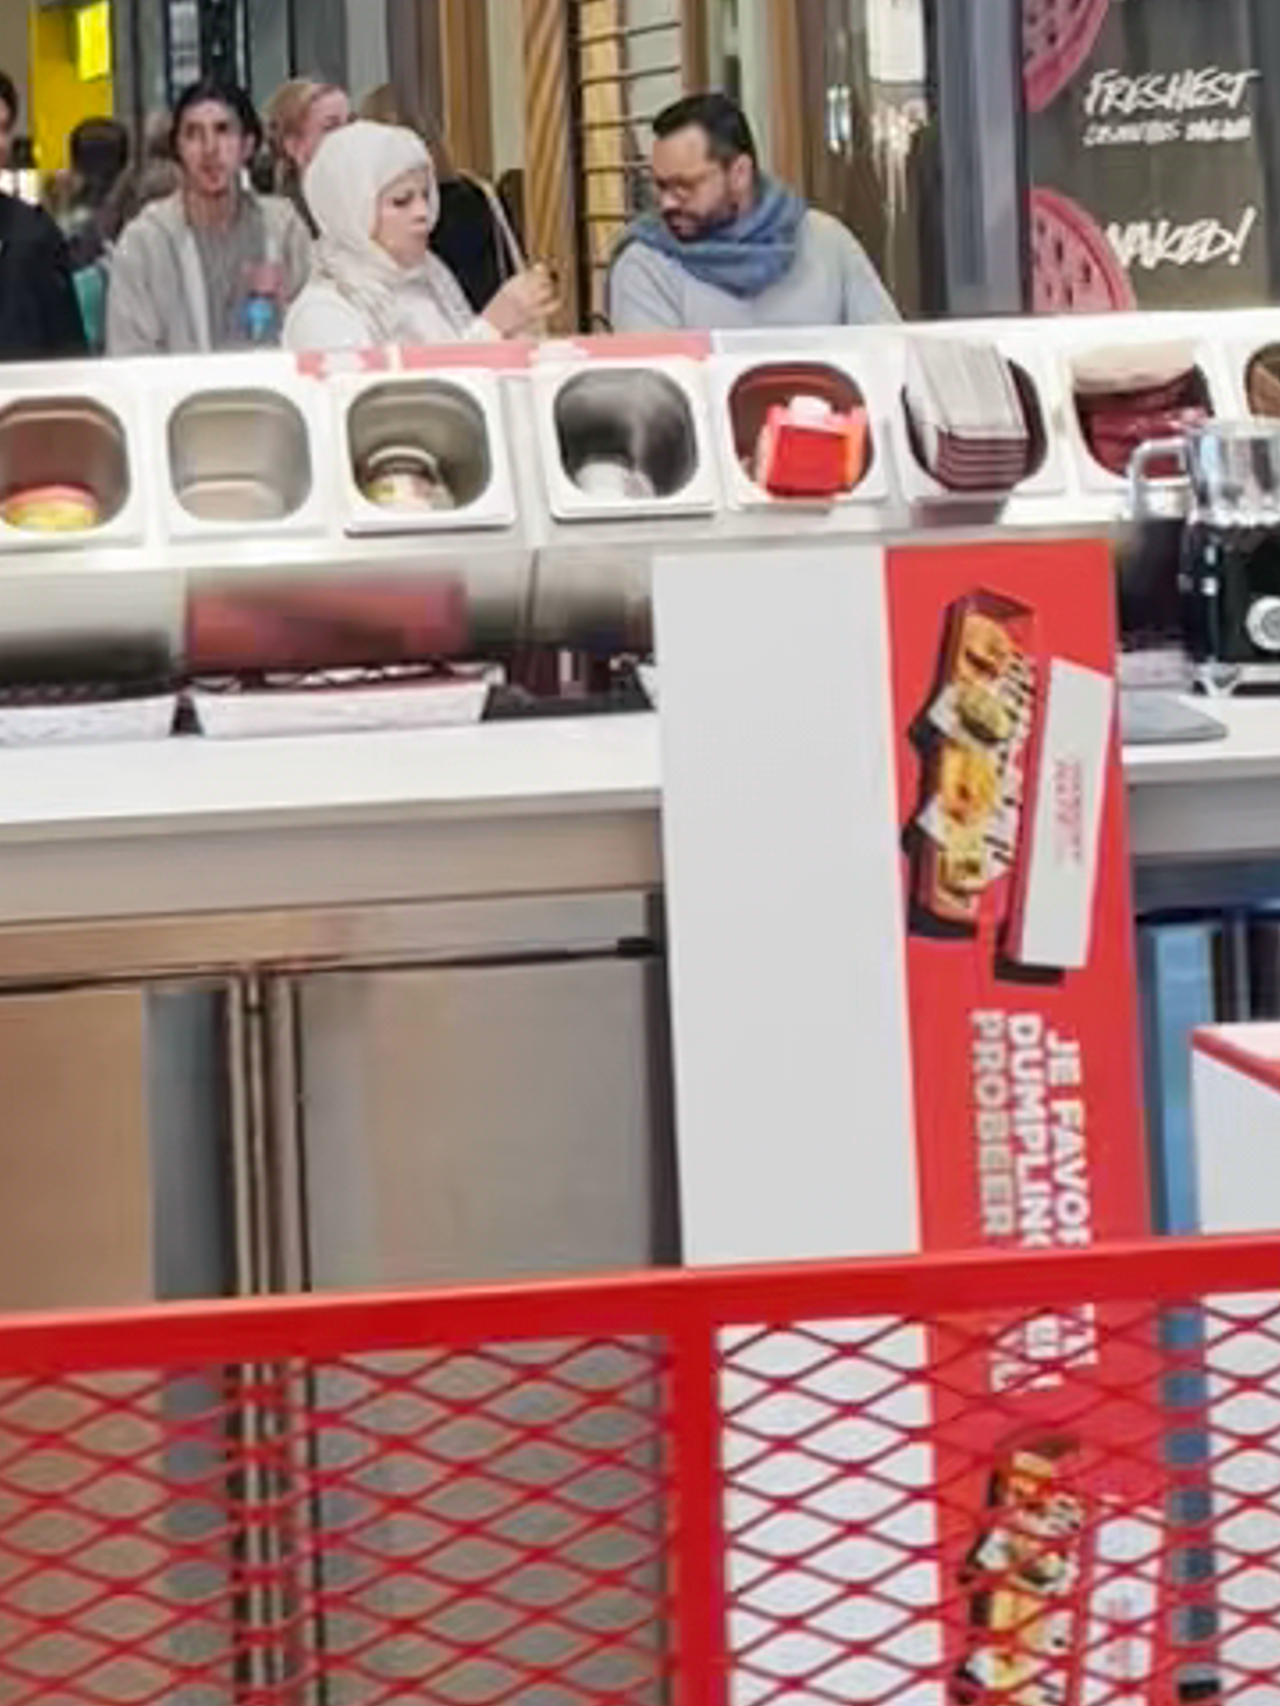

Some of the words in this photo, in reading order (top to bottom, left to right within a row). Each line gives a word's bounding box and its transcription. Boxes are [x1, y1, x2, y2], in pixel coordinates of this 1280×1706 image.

[1083, 68, 1261, 115] FRESHEST
[1046, 1029, 1082, 1085] JE
[970, 1009, 1017, 1236] PROBEER
